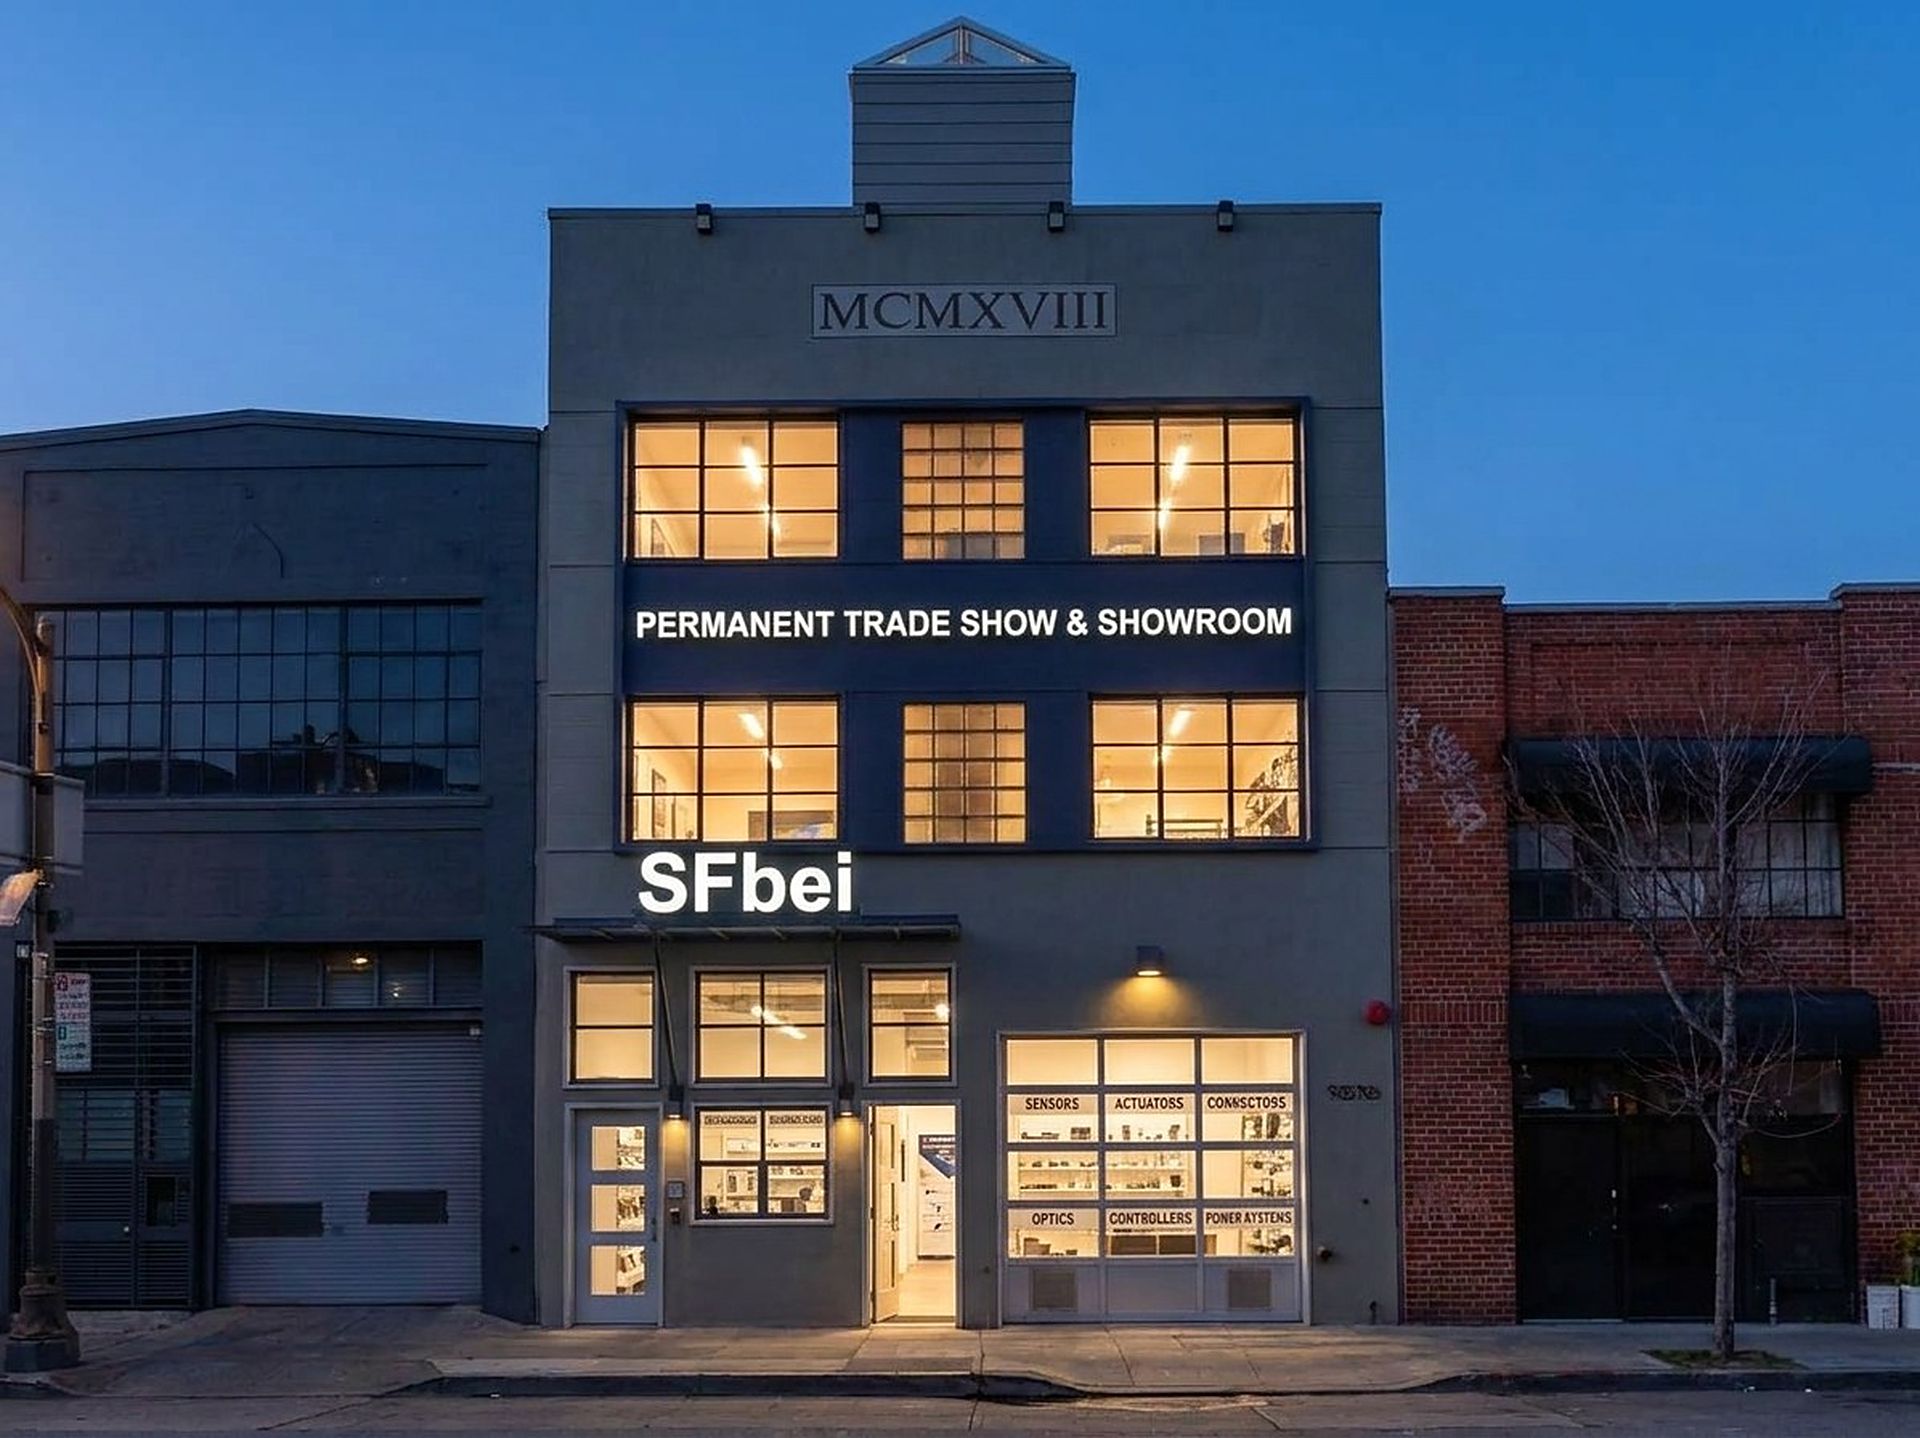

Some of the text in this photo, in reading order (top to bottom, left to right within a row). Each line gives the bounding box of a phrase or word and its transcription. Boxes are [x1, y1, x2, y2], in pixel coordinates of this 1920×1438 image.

[823, 293, 1107, 331] MCMXVIII
[636, 607, 1292, 640] PERMANENT TRADE SHOW & SHOWROOM
[638, 850, 852, 915] SFbei
[1025, 1097, 1079, 1110] SENSORS
[1031, 1212, 1075, 1225] OPTICS
